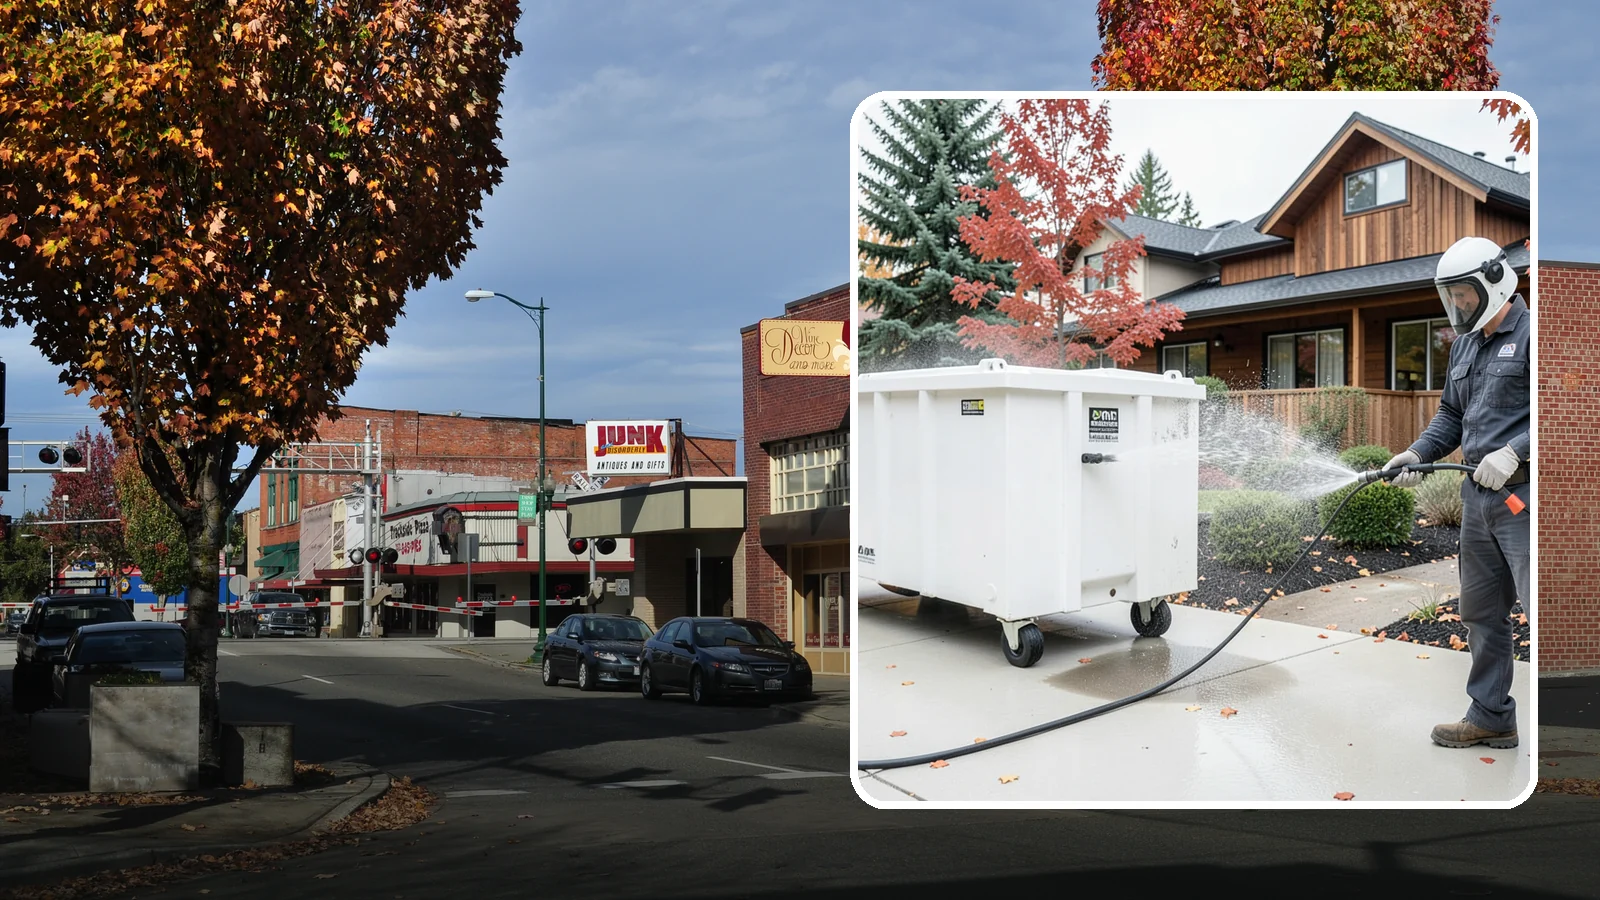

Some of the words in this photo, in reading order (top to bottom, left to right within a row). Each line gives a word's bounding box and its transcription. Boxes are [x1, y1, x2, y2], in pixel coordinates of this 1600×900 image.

[596, 425, 665, 457] JUNK
[597, 461, 628, 470] ANTIQUES
[631, 460, 644, 470] AND
[647, 460, 665, 470] GIFTS
[390, 520, 413, 540] Trackside
[414, 520, 428, 534] Pizza
